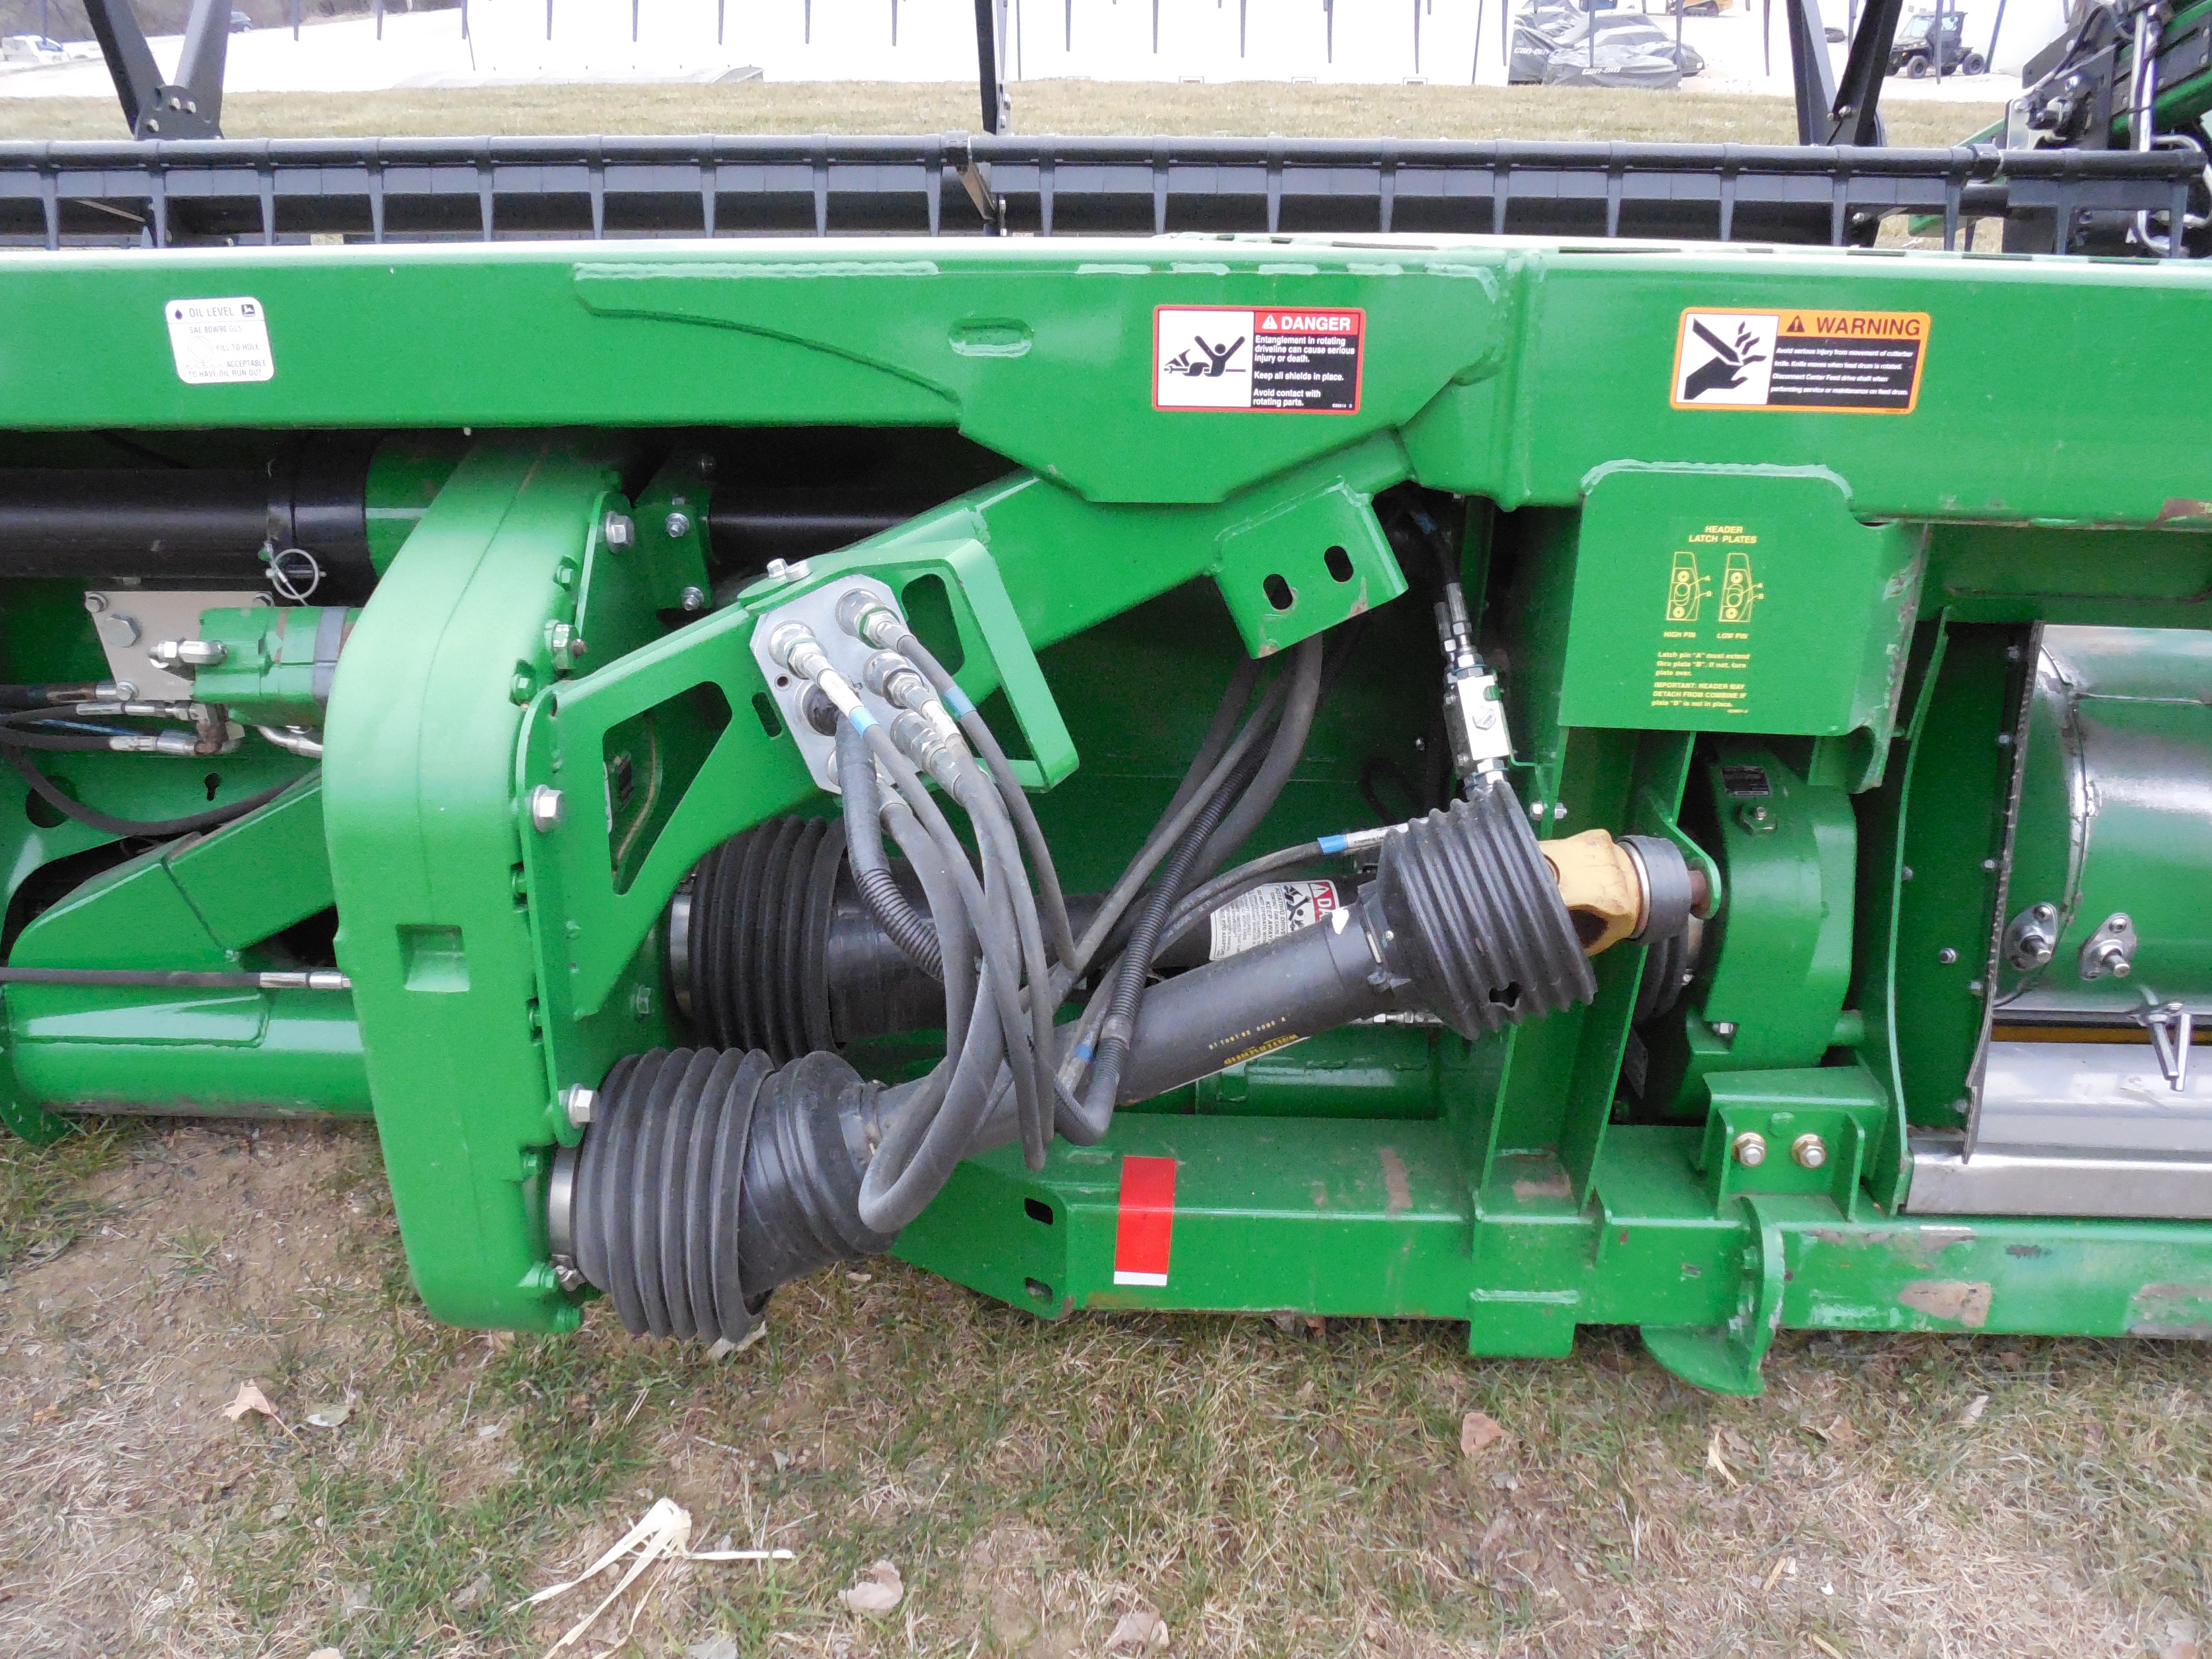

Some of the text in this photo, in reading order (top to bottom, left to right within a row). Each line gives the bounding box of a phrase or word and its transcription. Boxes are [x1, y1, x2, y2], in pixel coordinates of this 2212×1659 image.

[189, 307, 234, 317] OIL LEVEL
[1281, 316, 1351, 331] DANGER
[1816, 317, 1921, 336] WARNING
[1255, 335, 1306, 346] Entanglement
[1317, 337, 1346, 347] rotating
[1255, 345, 1286, 353] driveline
[1254, 353, 1275, 364] injury
[1287, 354, 1310, 362] death.
[1254, 371, 1273, 381] Keep
[1285, 372, 1311, 380] shields
[1313, 372, 1321, 380] in
[1322, 373, 1344, 382] place.
[1253, 388, 1274, 397] Avoid
[1305, 389, 1321, 397] with
[1253, 397, 1304, 407] rotating parts.
[1722, 535, 1757, 543] PLATES
[1275, 887, 1285, 914] ROTATING
